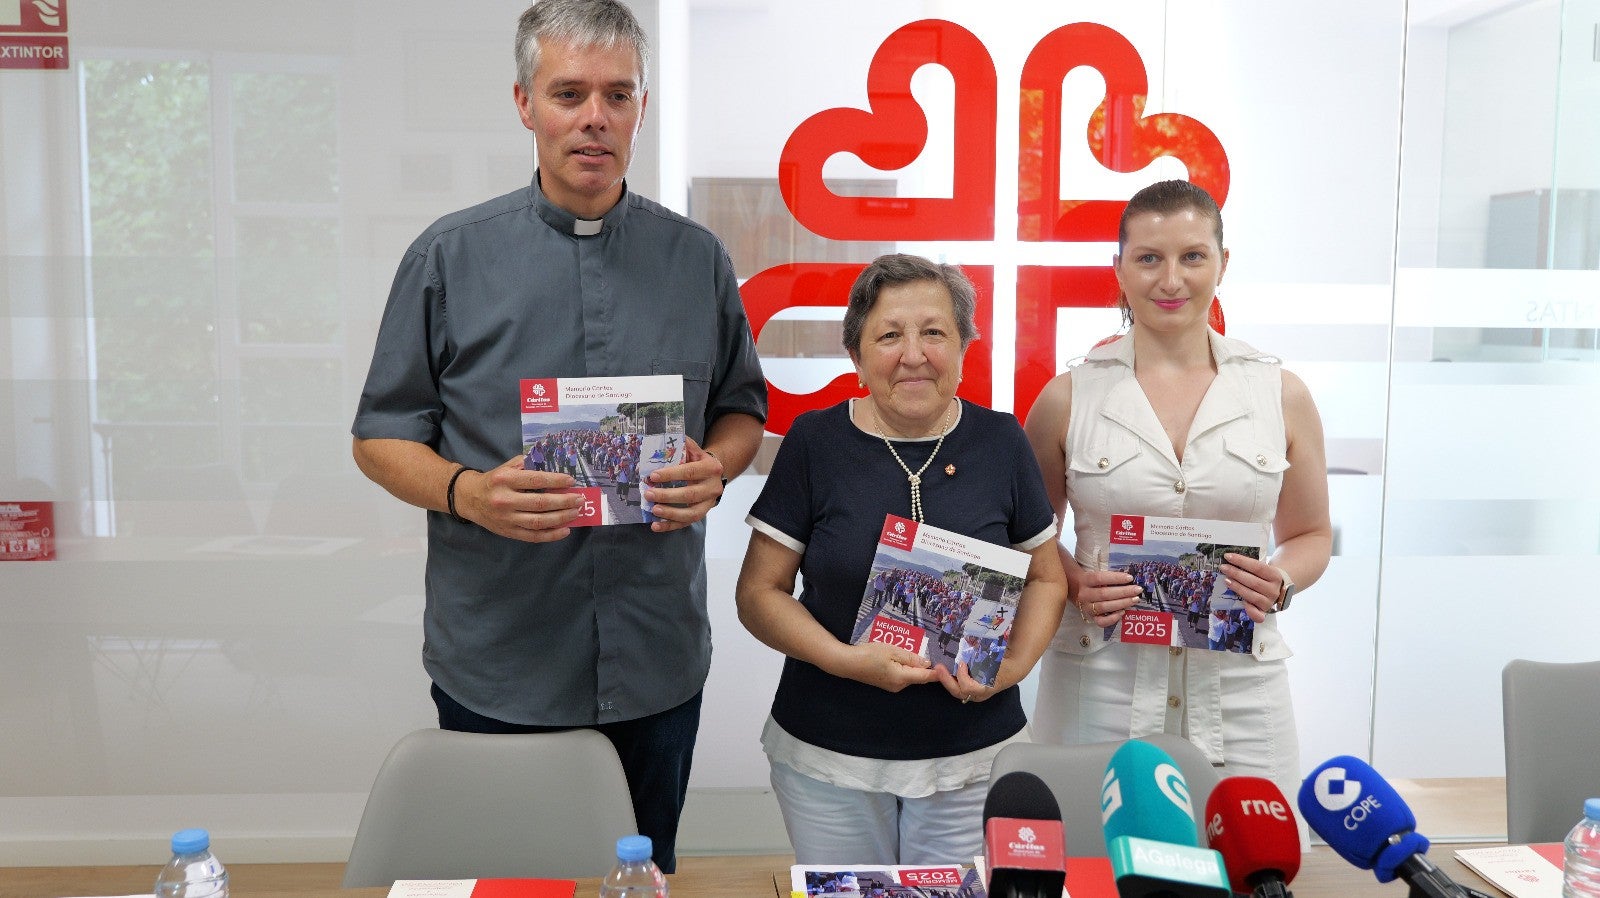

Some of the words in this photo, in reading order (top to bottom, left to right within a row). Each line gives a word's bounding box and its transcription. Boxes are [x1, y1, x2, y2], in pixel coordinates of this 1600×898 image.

[0, 45, 64, 59] XTINTOR
[876, 620, 910, 635] MEMORIA
[1124, 614, 1159, 622] MEMORIA
[1124, 621, 1166, 637] 2025
[872, 628, 916, 652] 2025
[1240, 798, 1288, 822] rne
[1343, 794, 1383, 831] COPE
[1206, 812, 1224, 844] ne
[1134, 846, 1217, 872] AGalega
[906, 871, 956, 881] 2025
